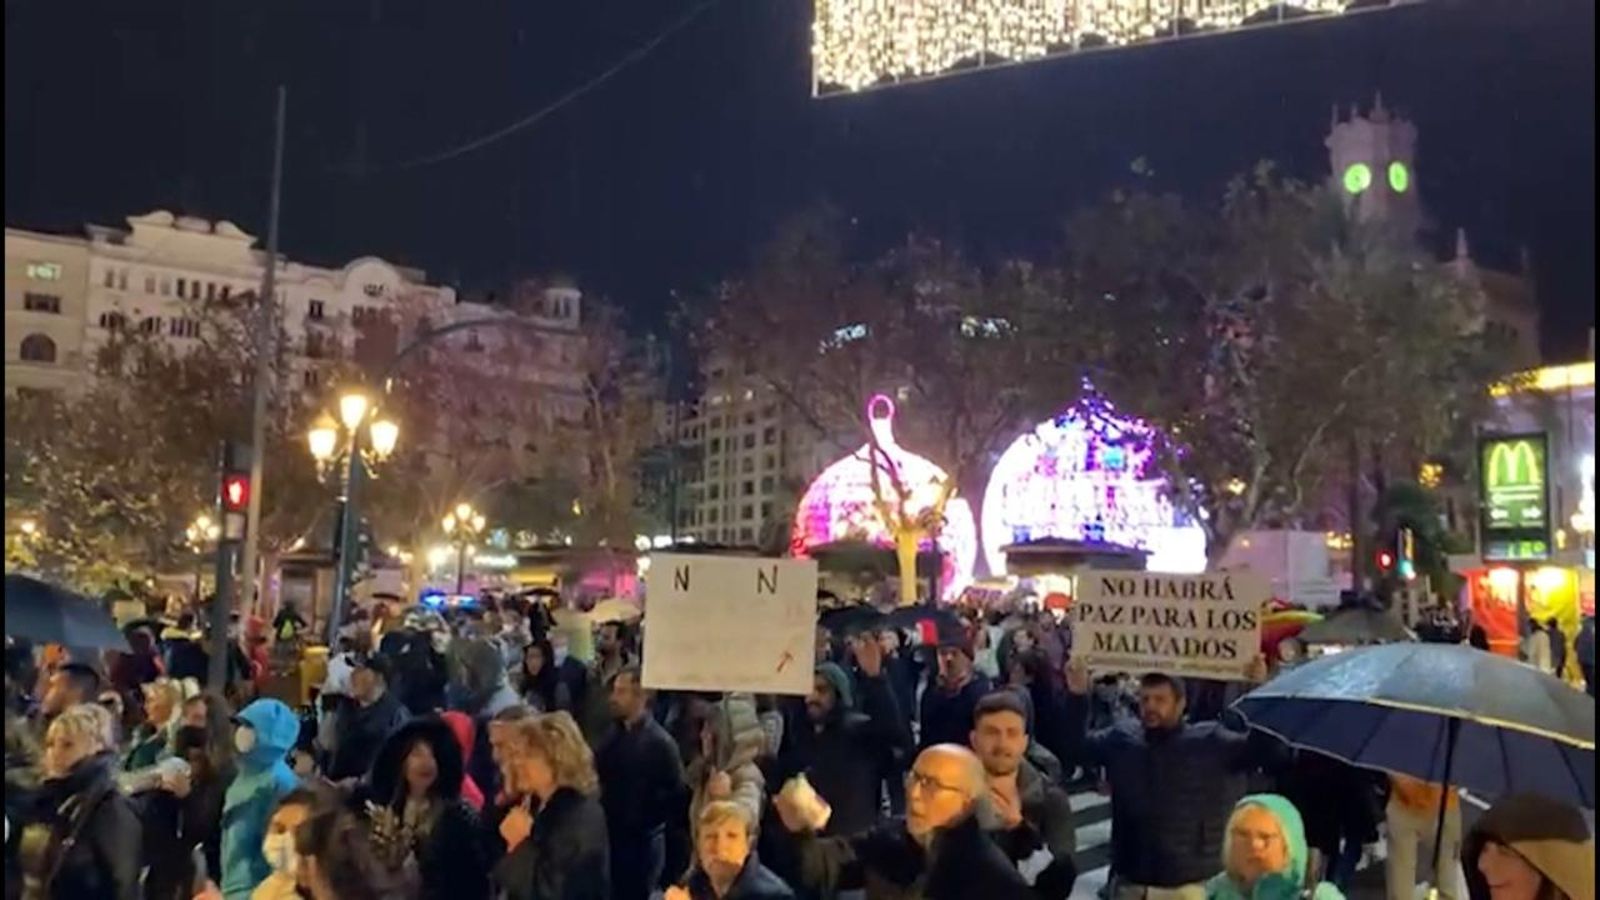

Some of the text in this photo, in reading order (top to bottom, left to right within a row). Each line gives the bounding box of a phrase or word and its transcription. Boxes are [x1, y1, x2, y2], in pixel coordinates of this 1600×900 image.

[674, 564, 778, 595] N N
[1101, 576, 1234, 600] NO HABRÁ
[1079, 604, 1256, 631] PAZ PARA LOS
[1093, 632, 1237, 658] MALVADOS
